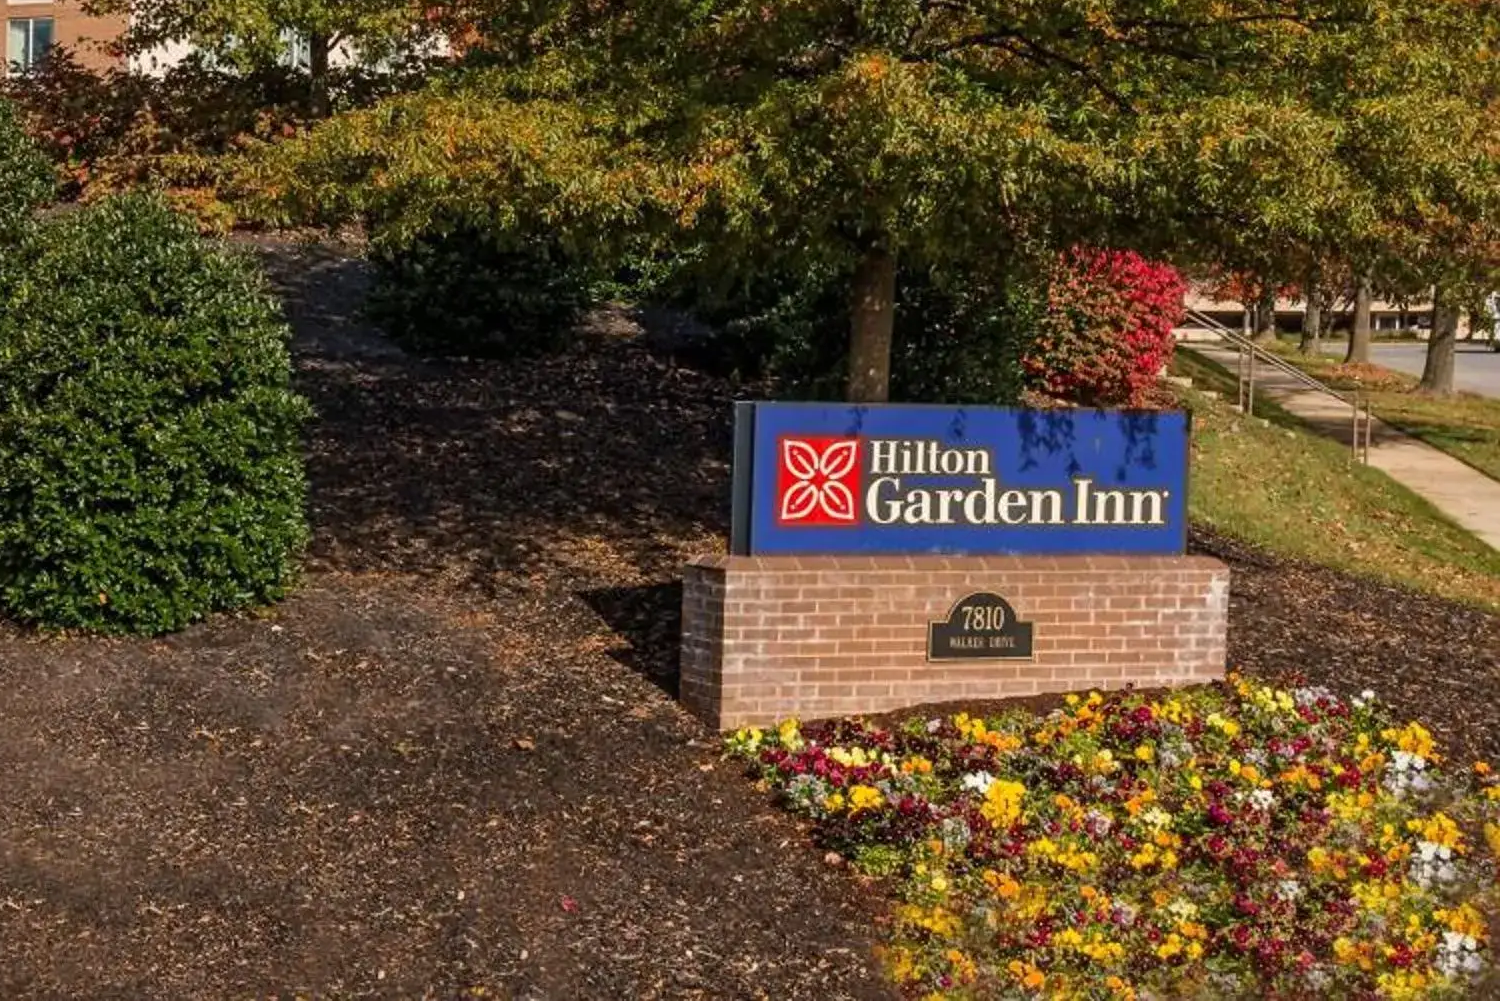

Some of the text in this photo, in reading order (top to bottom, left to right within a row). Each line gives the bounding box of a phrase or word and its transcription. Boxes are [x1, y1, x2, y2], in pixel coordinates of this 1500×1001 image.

[869, 440, 990, 475] Hilton
[865, 477, 1165, 525] Garden Inn
[961, 606, 1005, 631] 7810
